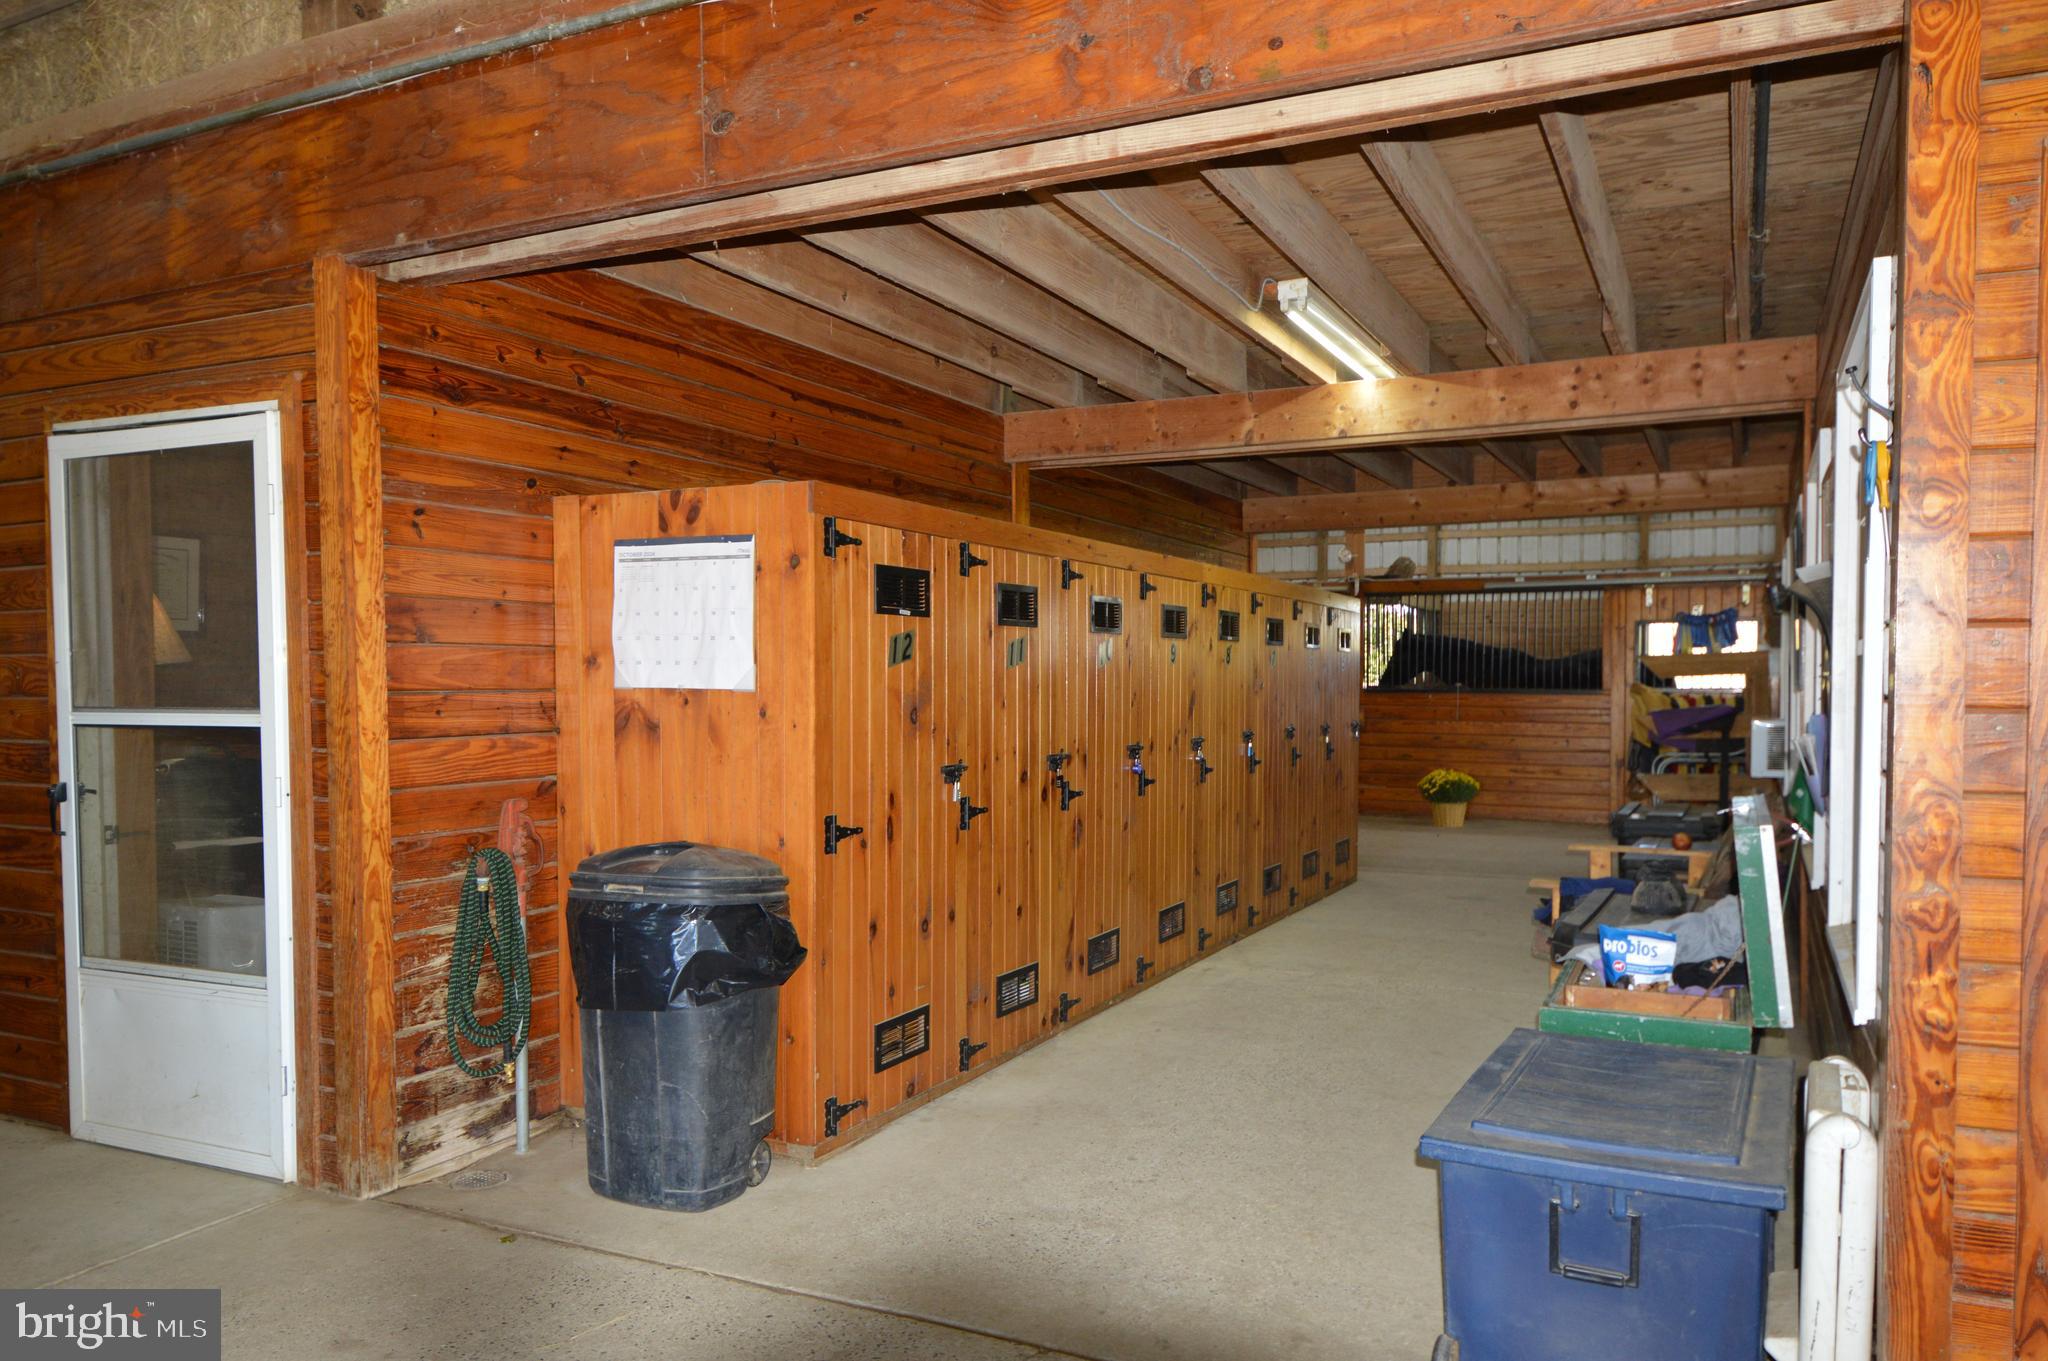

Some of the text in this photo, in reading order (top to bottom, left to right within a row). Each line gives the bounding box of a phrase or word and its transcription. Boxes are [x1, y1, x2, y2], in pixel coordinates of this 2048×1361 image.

[893, 632, 912, 664] 12
[1010, 638, 1023, 666] 11
[1170, 643, 1177, 663] 9
[1226, 645, 1232, 664] 8
[1603, 937, 1658, 958] probios
